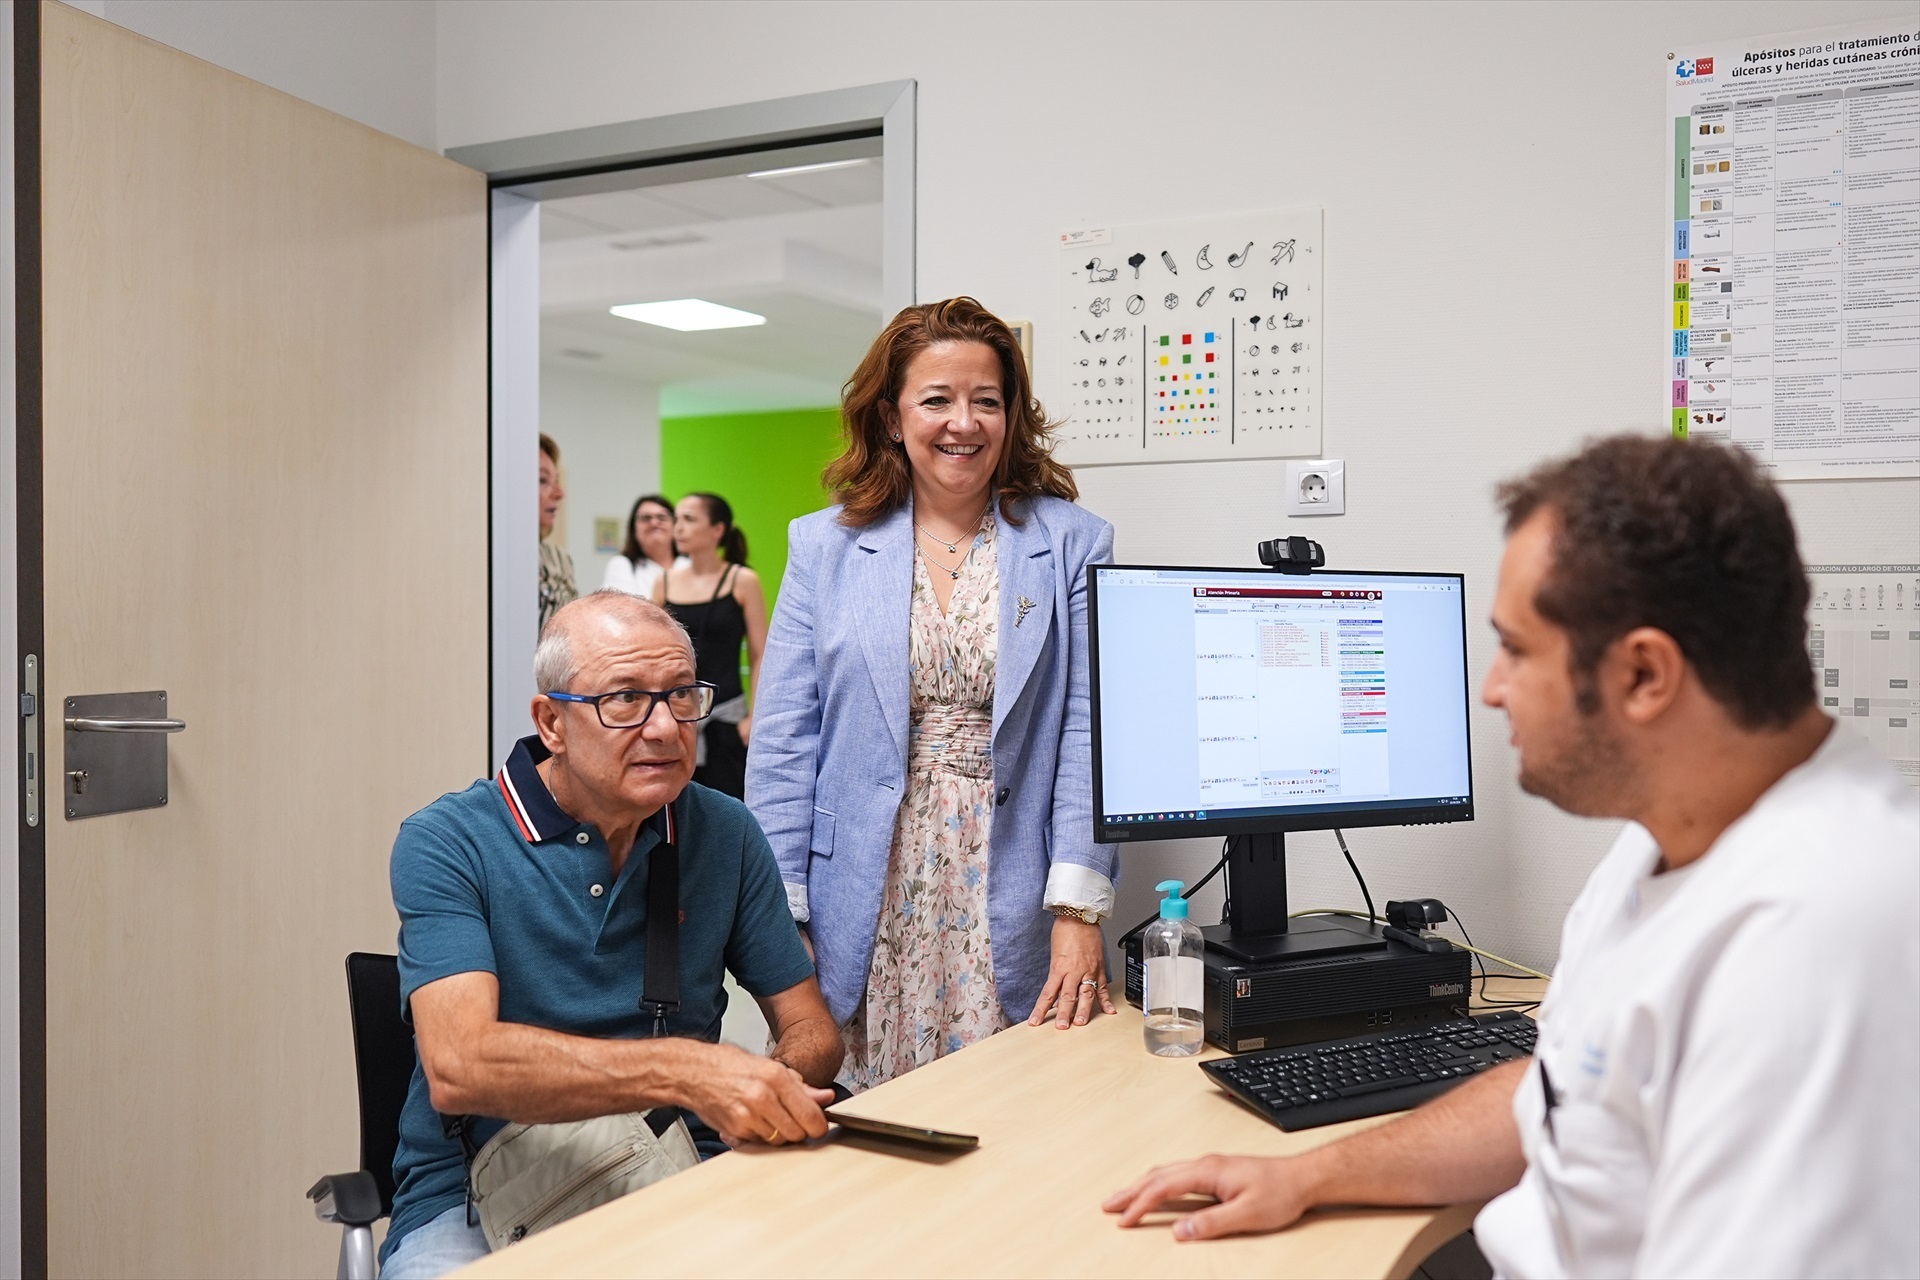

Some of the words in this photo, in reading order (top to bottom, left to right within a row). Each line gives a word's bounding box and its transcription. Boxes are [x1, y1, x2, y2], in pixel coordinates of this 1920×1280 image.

[1744, 48, 1796, 63] Apósitos
[1799, 45, 1822, 57] para
[1825, 42, 1835, 52] el
[1839, 33, 1910, 50] tratamiento
[1732, 65, 1772, 77] úlceras
[1775, 64, 1783, 74] y
[1786, 58, 1829, 71] heridas
[1832, 51, 1887, 65] cutáneas
[1675, 76, 1714, 87] SaludMadrid
[1429, 983, 1464, 997] ThinkCentre
[1240, 1039, 1263, 1048] Lenovo
